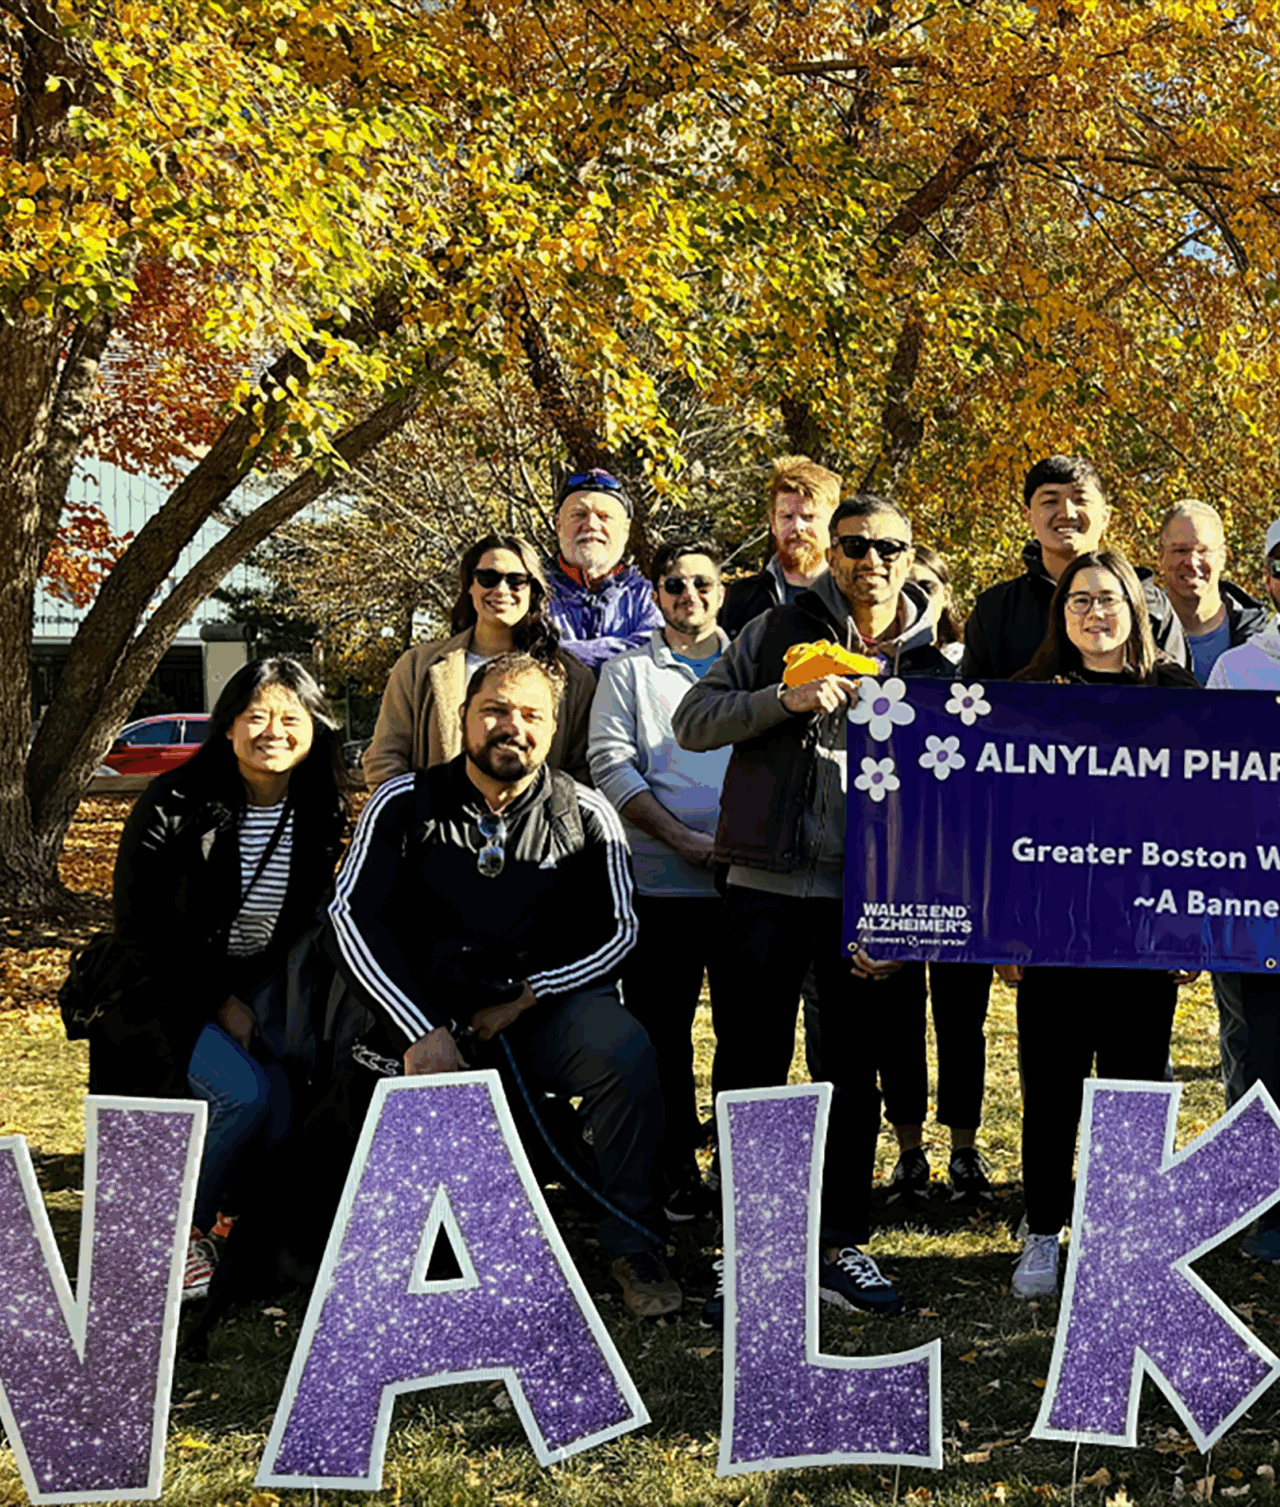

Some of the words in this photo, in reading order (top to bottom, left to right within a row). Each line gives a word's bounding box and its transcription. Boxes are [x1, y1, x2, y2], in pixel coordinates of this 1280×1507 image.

[975, 742, 1170, 778] ALNYLAM
[1012, 837, 1132, 865] Greater
[1142, 841, 1247, 869] Boston
[862, 902, 914, 917] WALK
[930, 904, 968, 919] END
